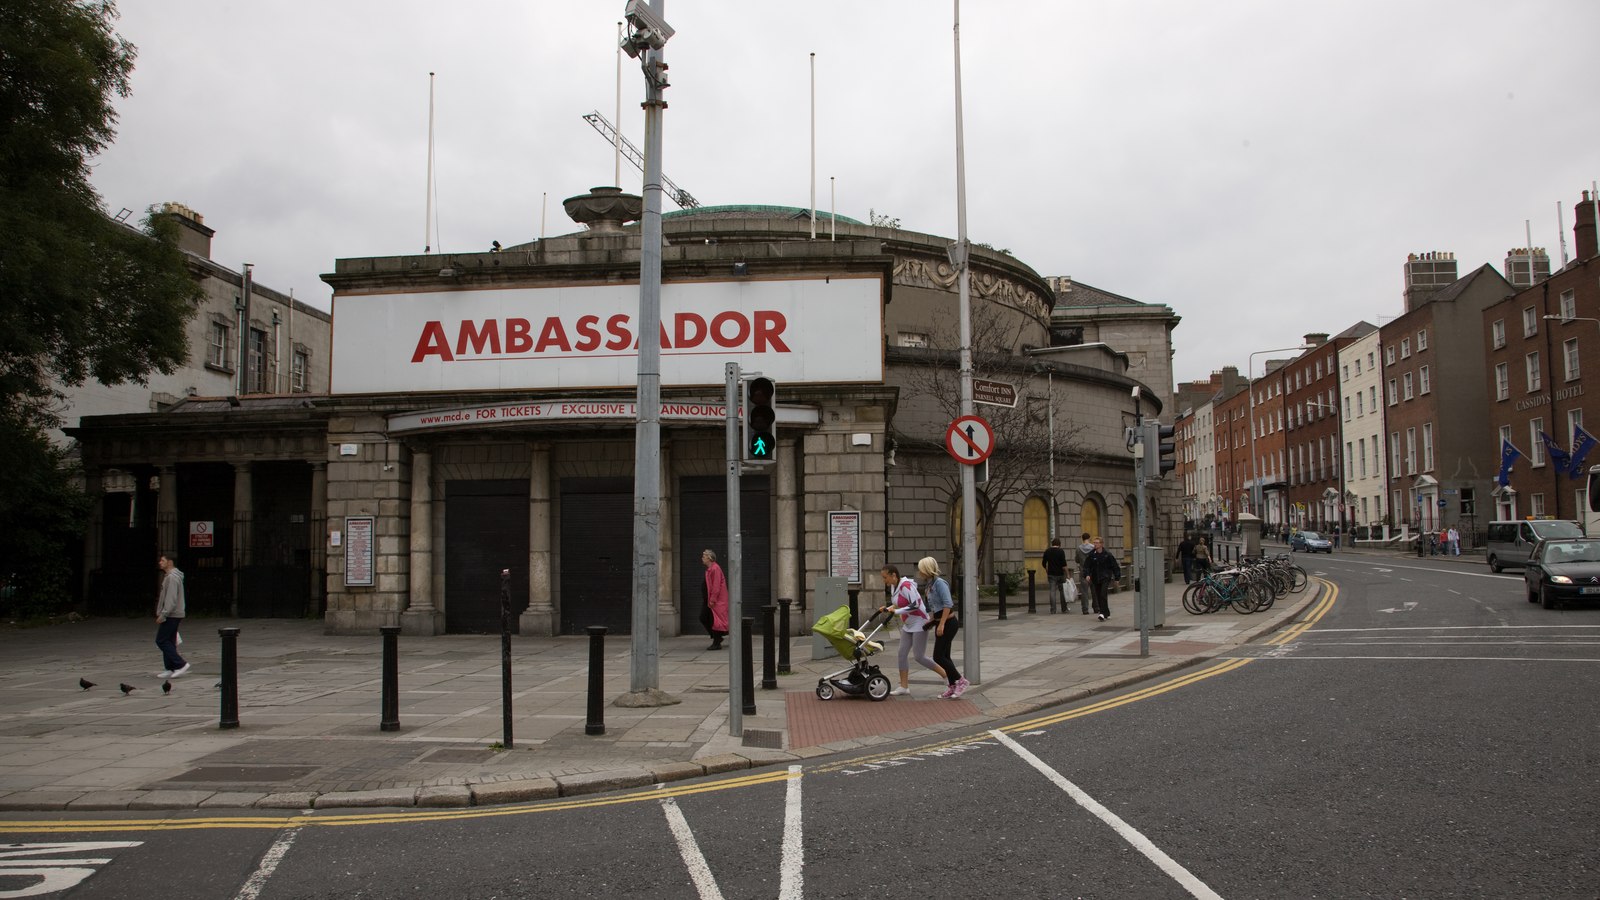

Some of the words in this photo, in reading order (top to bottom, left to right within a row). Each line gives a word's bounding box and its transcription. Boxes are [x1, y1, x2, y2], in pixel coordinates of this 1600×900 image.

[974, 380, 1000, 394] Comfort
[1000, 386, 1012, 396] INN
[1516, 393, 1551, 411] CASSIDYS
[1556, 384, 1585, 401] HOTEL
[476, 408, 496, 420] FOR
[501, 405, 541, 418] TICKETS
[561, 404, 625, 415] EXCLUSIVE
